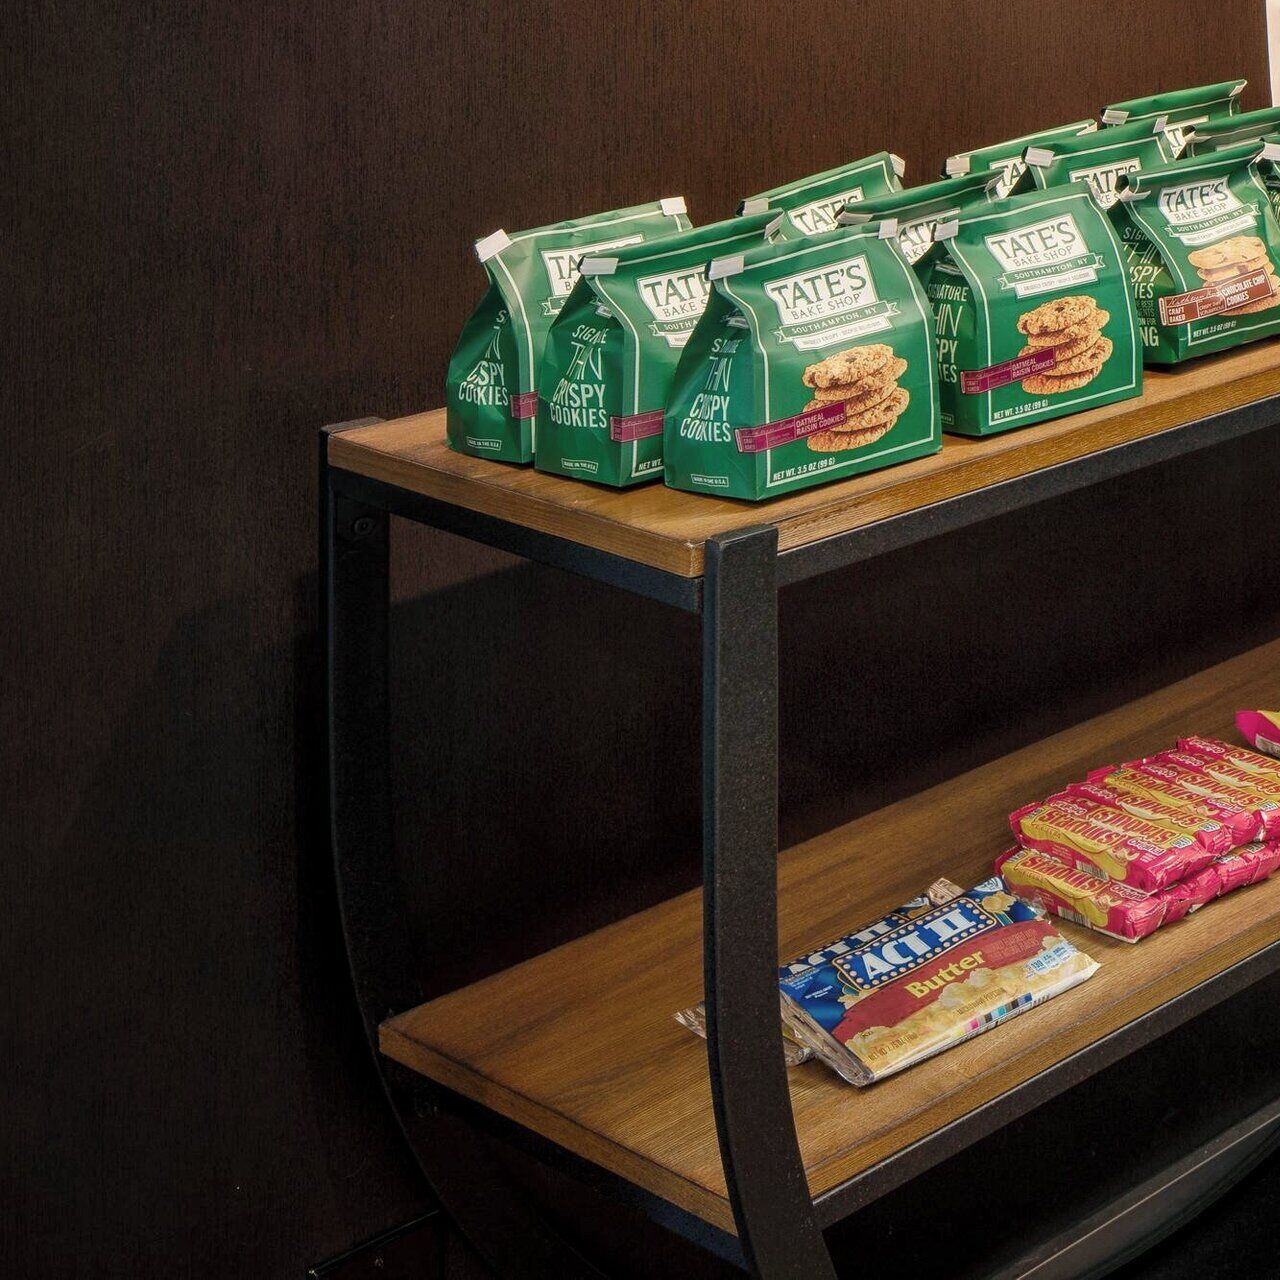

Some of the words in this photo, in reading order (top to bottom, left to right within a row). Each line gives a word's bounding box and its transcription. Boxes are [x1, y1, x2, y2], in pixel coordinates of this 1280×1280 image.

[1163, 181, 1228, 213] TATE'S
[1174, 210, 1200, 221] BAKE
[1201, 203, 1227, 218] SHOP
[991, 219, 1076, 261] TATE'S
[1013, 254, 1041, 267] BAKE
[1043, 245, 1072, 261] SHOP
[770, 263, 867, 311] TATE'S
[1222, 279, 1252, 297] CHOCOLATE
[1251, 274, 1266, 286] CHIP
[663, 300, 697, 317] BAKE
[791, 304, 823, 320] BAKE
[827, 292, 860, 311] SHOP
[1227, 292, 1249, 306] COOKIES
[1168, 307, 1185, 315] CRAFT
[1012, 357, 1036, 371] OATMEAL
[1031, 358, 1054, 374] COOKIES
[552, 378, 606, 408] CRISPY
[550, 402, 607, 428] COOKIES
[796, 412, 824, 428] OATMEAL
[796, 420, 818, 435] RAISIN
[818, 412, 845, 430] COOKIES
[993, 412, 1003, 421] NET
[773, 470, 785, 481] NET
[797, 465, 807, 476] 3.5
[862, 930, 932, 980] ACT
[923, 908, 977, 943] II
[904, 950, 986, 999] Butter
